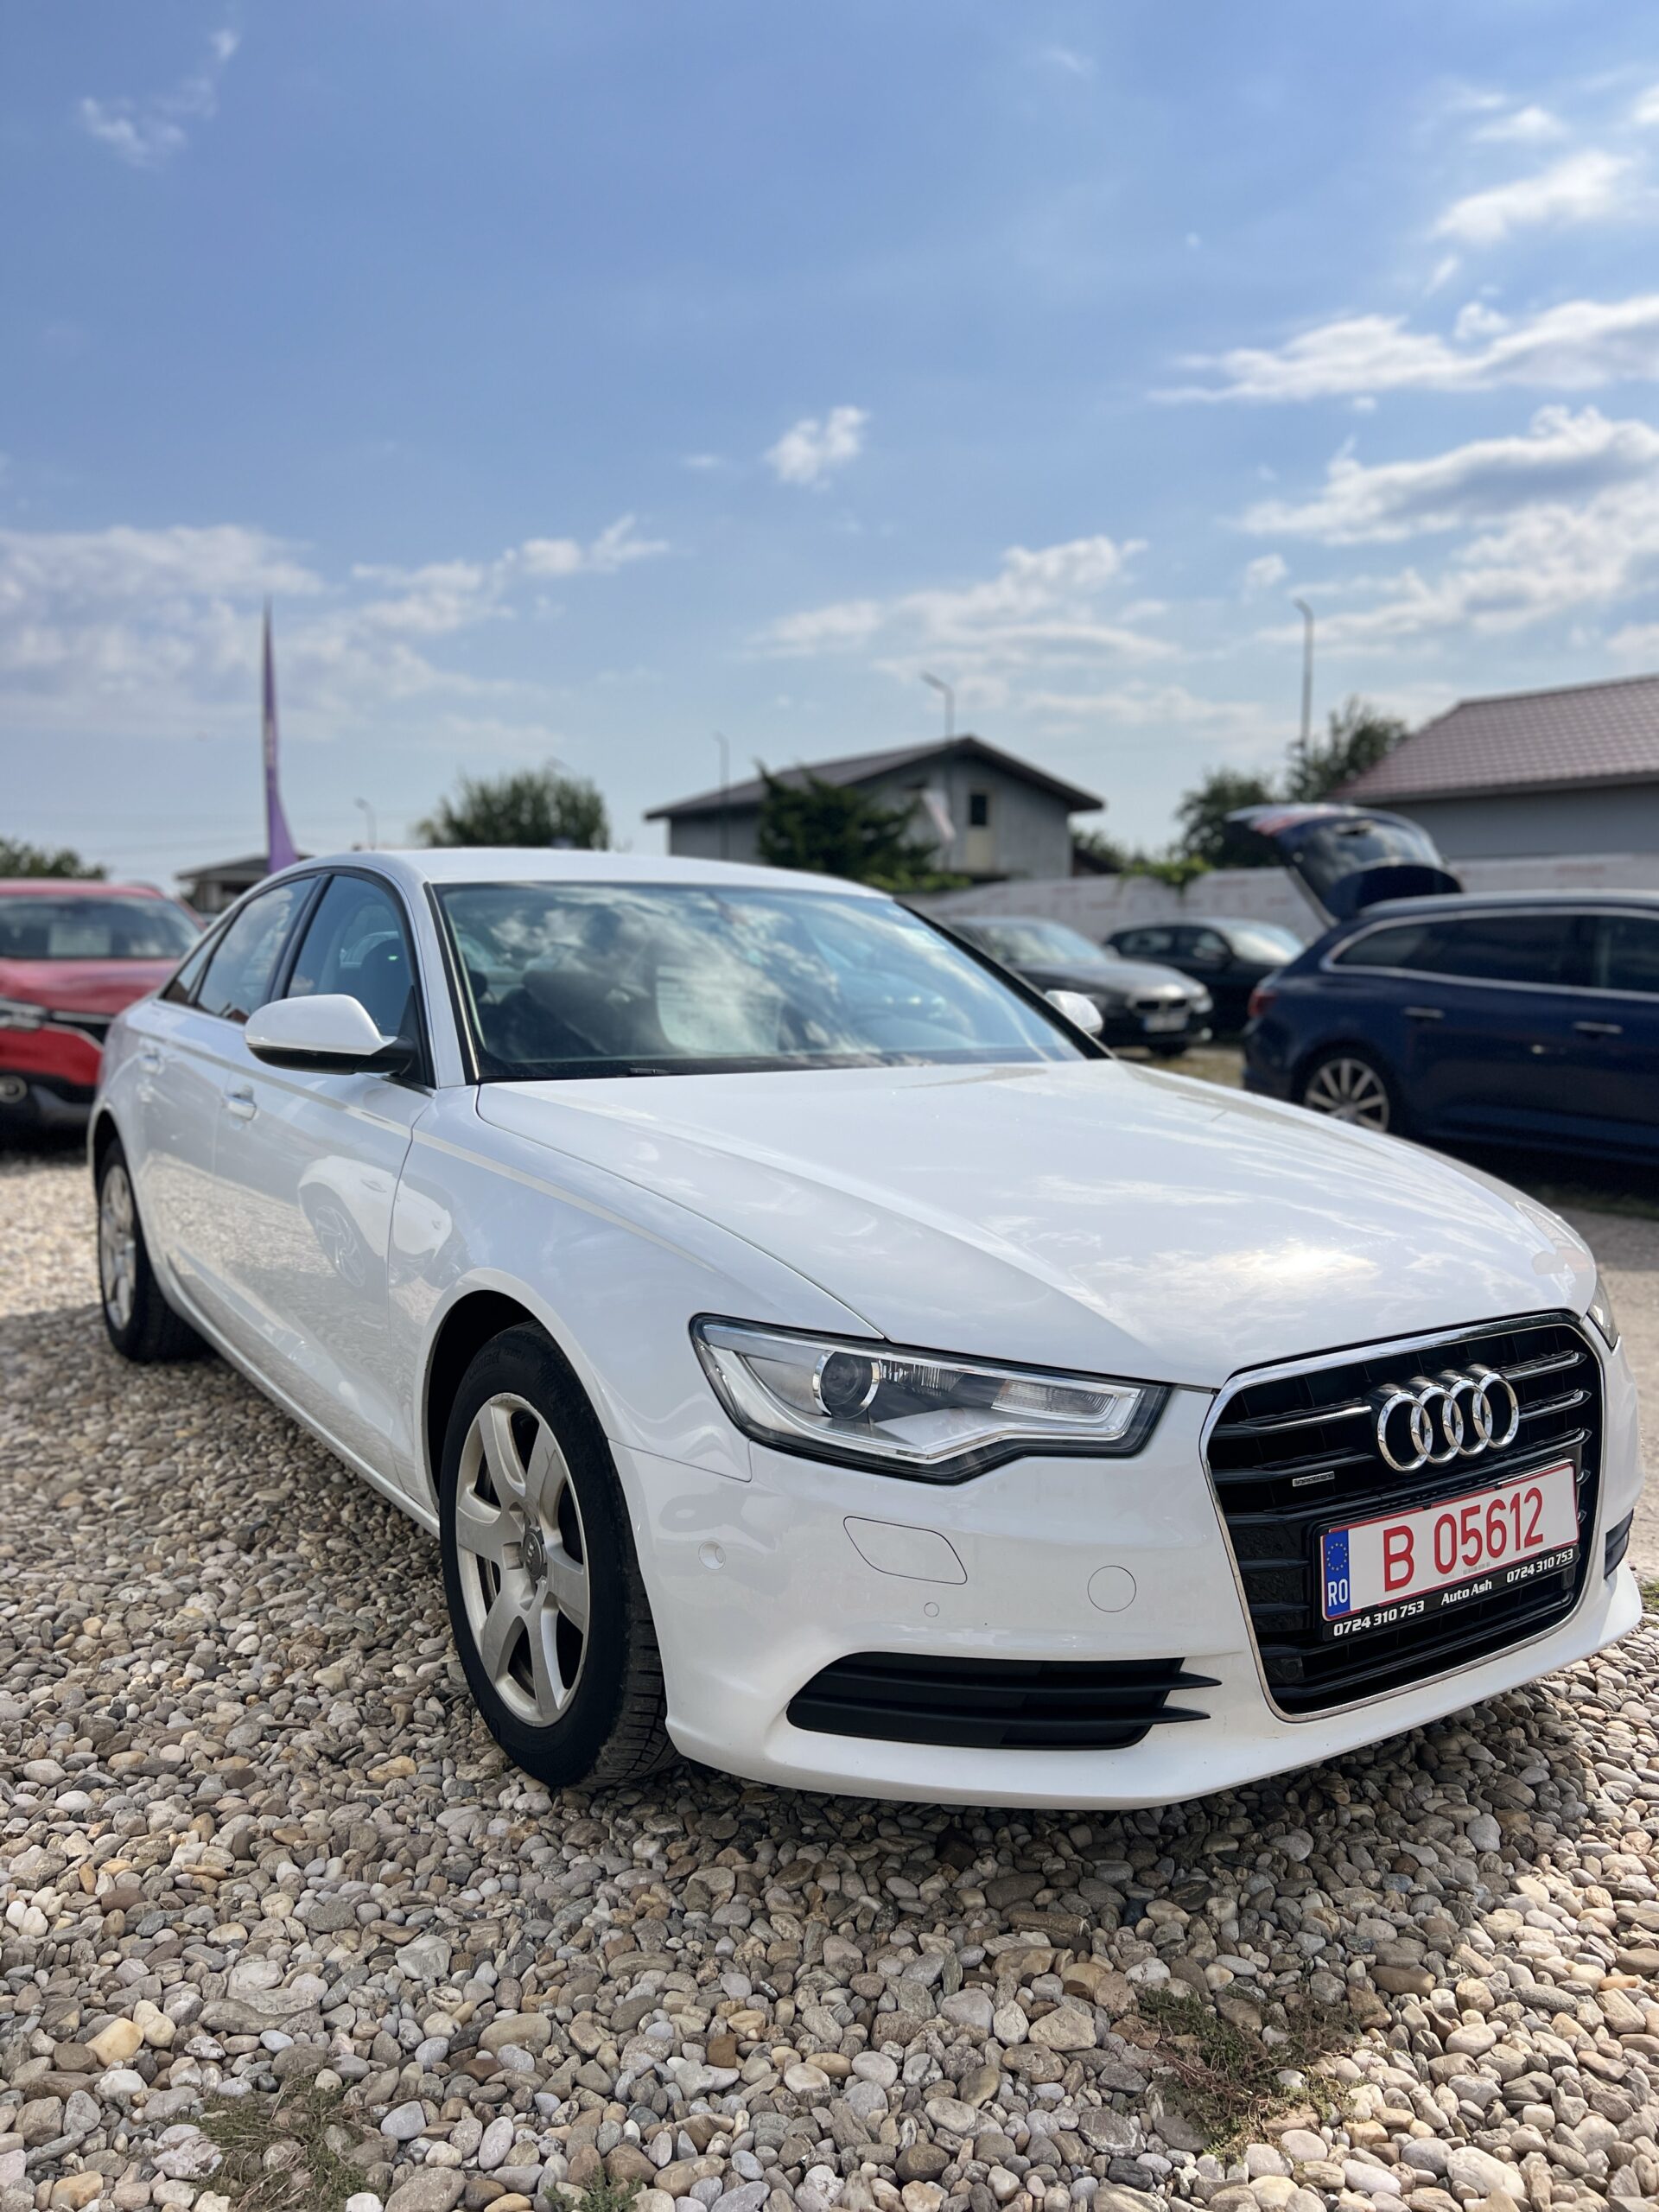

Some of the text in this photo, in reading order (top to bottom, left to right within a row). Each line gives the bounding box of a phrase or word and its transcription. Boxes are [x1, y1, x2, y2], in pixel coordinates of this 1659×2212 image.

[1383, 1487, 1543, 1592] B 05612
[1327, 1579, 1349, 1607] RO
[1333, 1616, 1371, 1637] 0724
[1373, 1608, 1398, 1626] 310
[1400, 1600, 1425, 1618] 753
[1440, 1588, 1470, 1605] Auto
[1471, 1580, 1492, 1597] Ash
[1506, 1564, 1534, 1583] 0724
[1535, 1556, 1554, 1573] 310
[1555, 1548, 1573, 1565] 753
